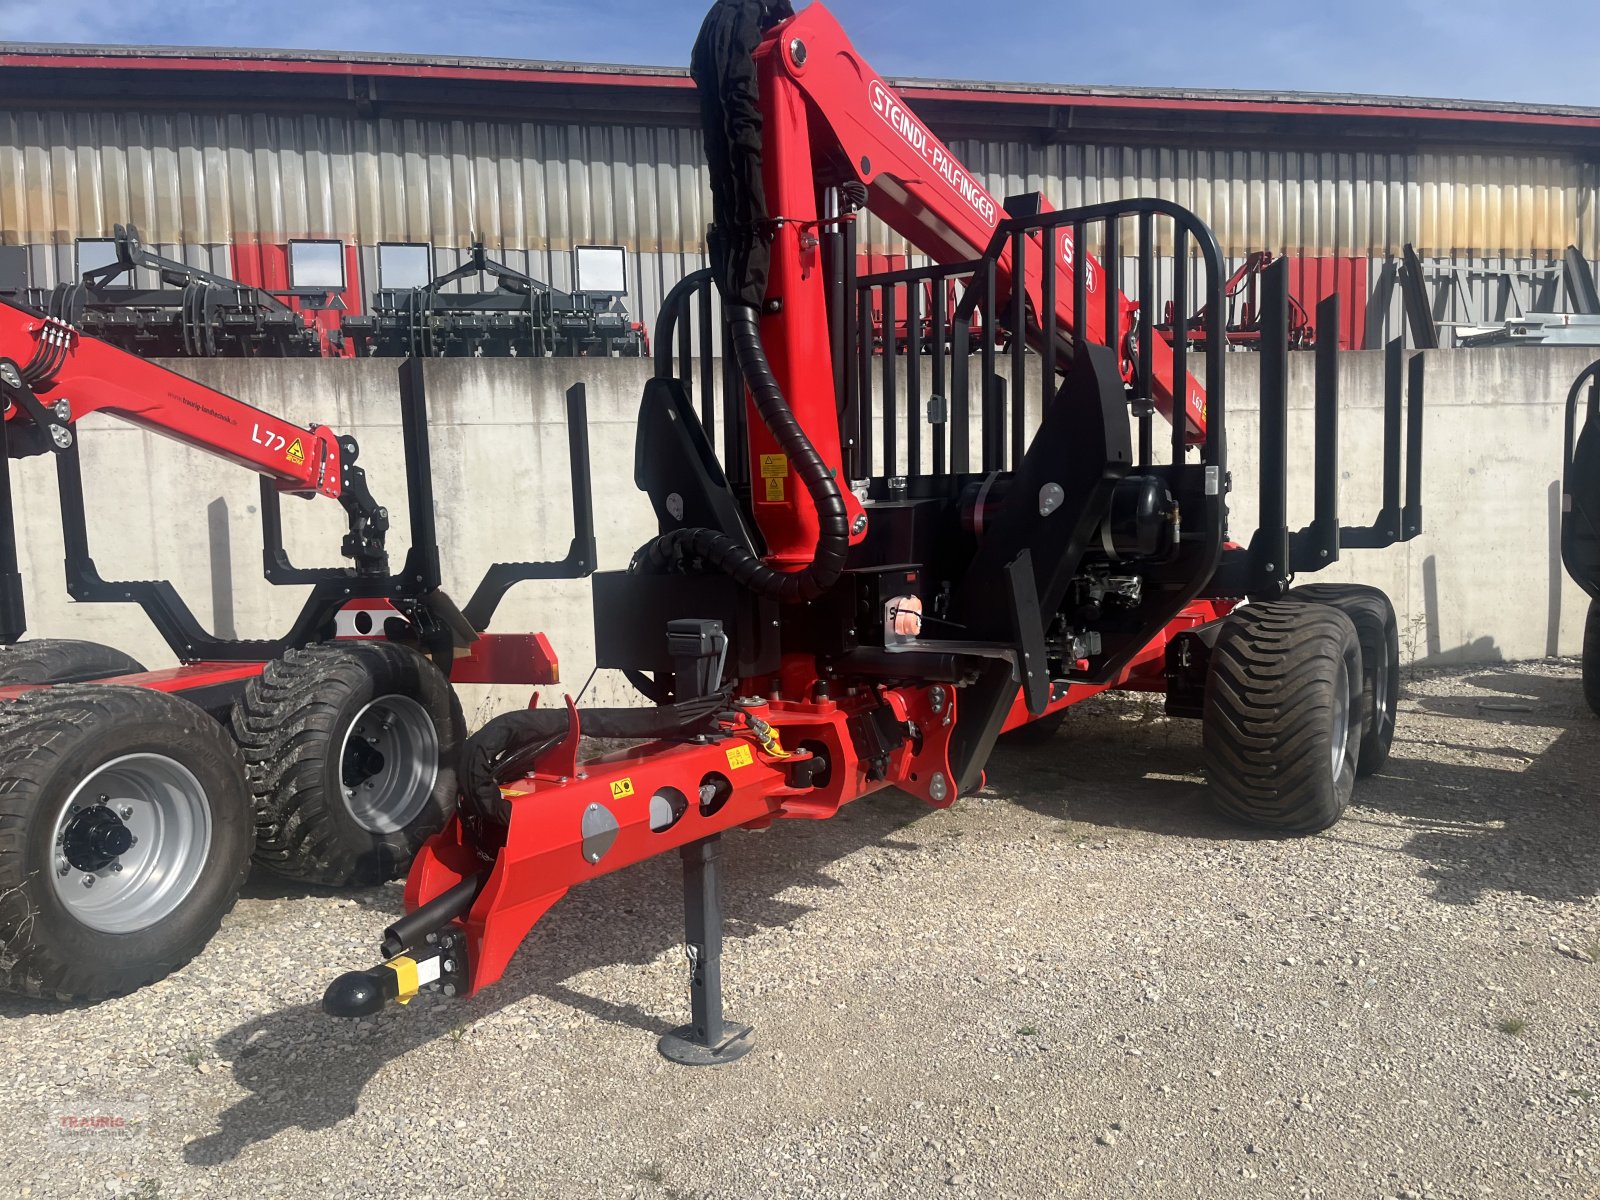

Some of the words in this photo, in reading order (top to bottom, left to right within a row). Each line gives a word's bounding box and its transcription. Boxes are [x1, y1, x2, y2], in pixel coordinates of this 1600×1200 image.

[873, 86, 994, 223] STEINDL-PALFINGER
[1192, 389, 1202, 413] L62
[252, 423, 285, 451] L72
